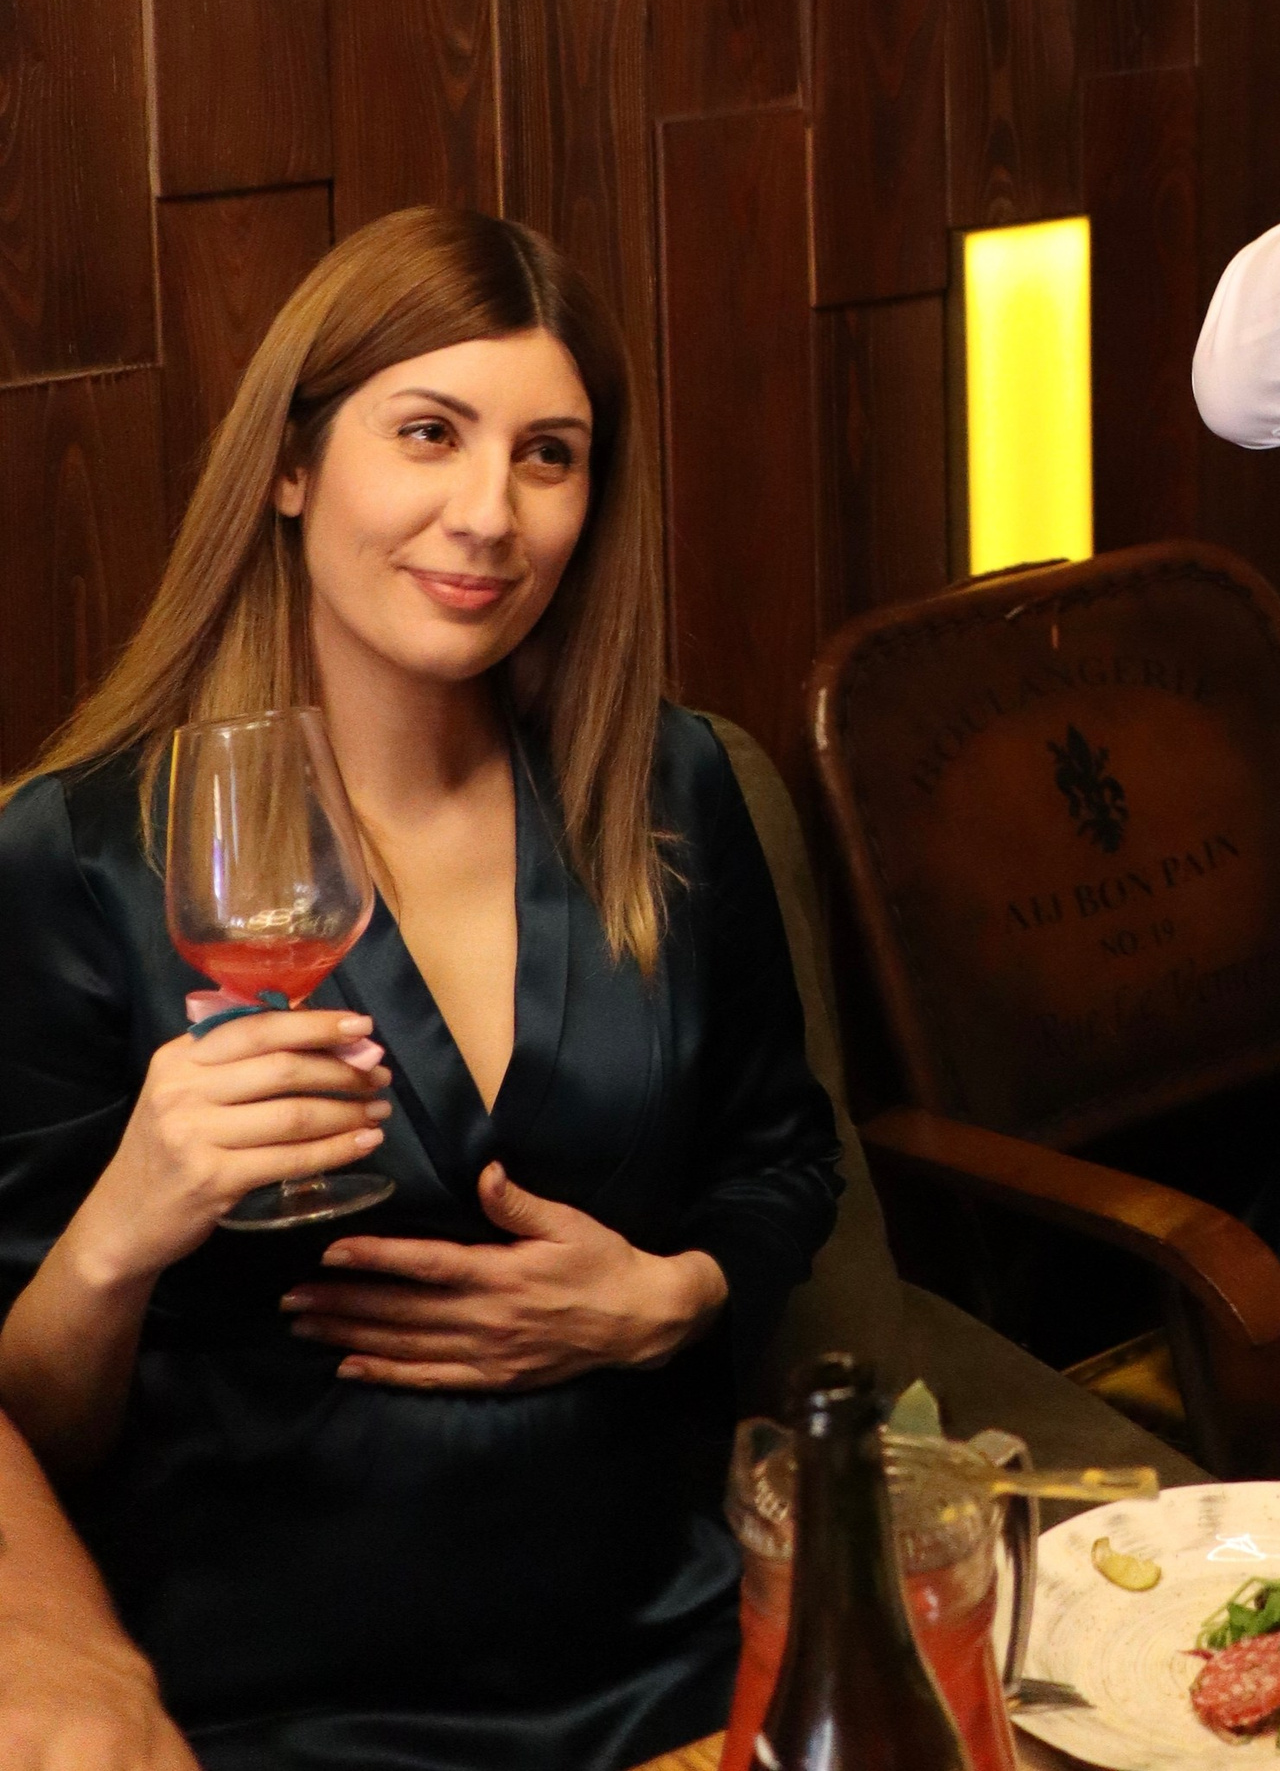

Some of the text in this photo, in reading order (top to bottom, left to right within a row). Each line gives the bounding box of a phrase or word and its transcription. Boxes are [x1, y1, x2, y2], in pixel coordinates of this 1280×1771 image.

[911, 655, 1214, 795] BOULANGERIE
[1073, 870, 1155, 919] BON
[1160, 833, 1241, 889] PAIN
[1150, 916, 1176, 948] 19
